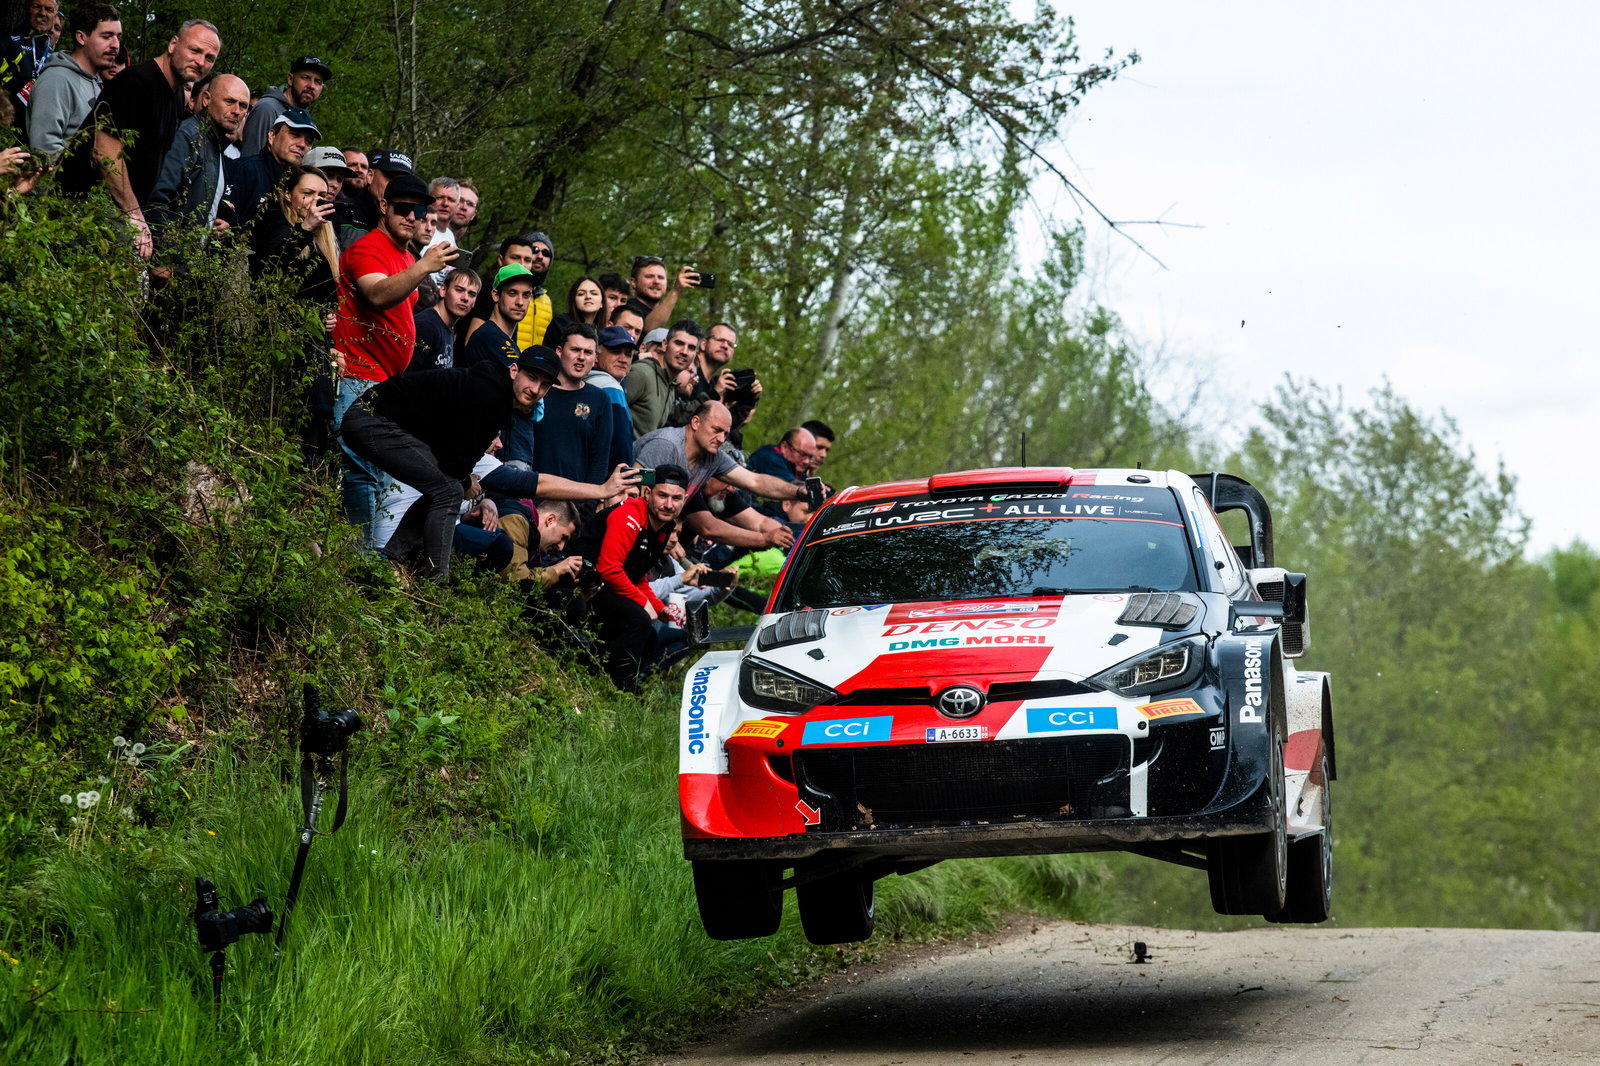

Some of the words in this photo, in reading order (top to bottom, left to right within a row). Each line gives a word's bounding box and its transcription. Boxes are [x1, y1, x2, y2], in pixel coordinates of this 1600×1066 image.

[900, 496, 984, 509] TOYOTA
[1071, 492, 1145, 503] Racing
[875, 507, 976, 527] WRC
[1004, 504, 1052, 515] ALL
[1059, 504, 1115, 515] LIVE
[880, 618, 1057, 637] DENSO
[888, 637, 960, 651] DMG
[965, 635, 1046, 645] MORI
[688, 665, 720, 755] Panasonic
[1142, 700, 1198, 717] PIRELLI
[735, 722, 782, 736] PIRELLI
[940, 728, 978, 739] A-6633
[1210, 731, 1225, 746] OMP
